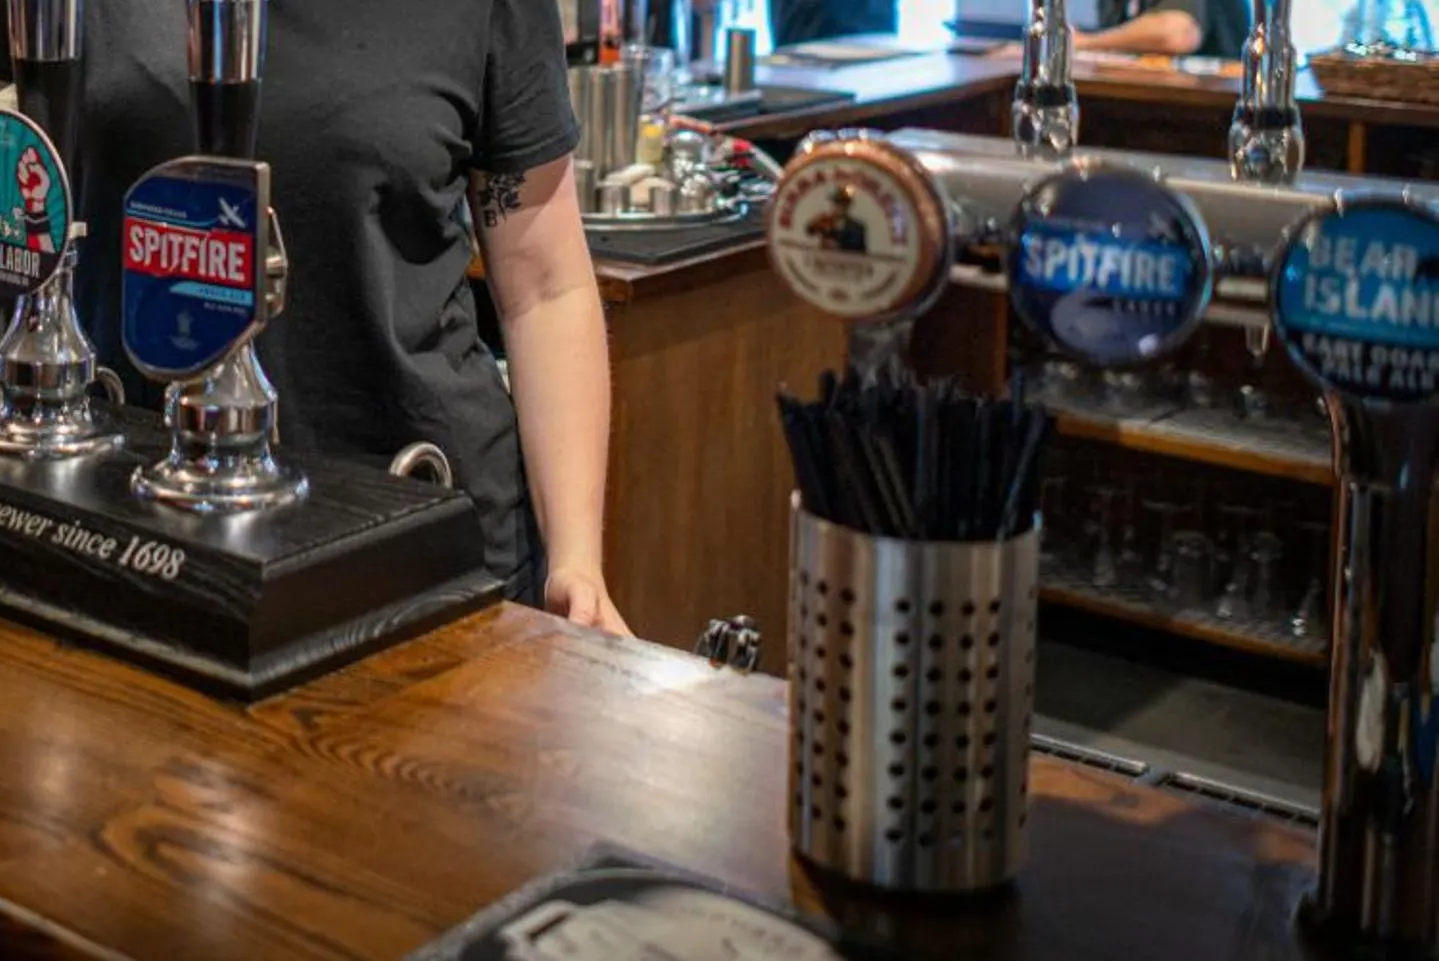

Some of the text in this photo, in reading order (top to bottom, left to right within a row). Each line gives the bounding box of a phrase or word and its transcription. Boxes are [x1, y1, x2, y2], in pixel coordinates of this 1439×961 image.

[129, 224, 246, 282] SPITFIRE
[1022, 234, 1177, 295] SPITFIRE
[1310, 236, 1417, 281] BEAR
[53, 520, 118, 559] since
[119, 535, 186, 580] 1698
